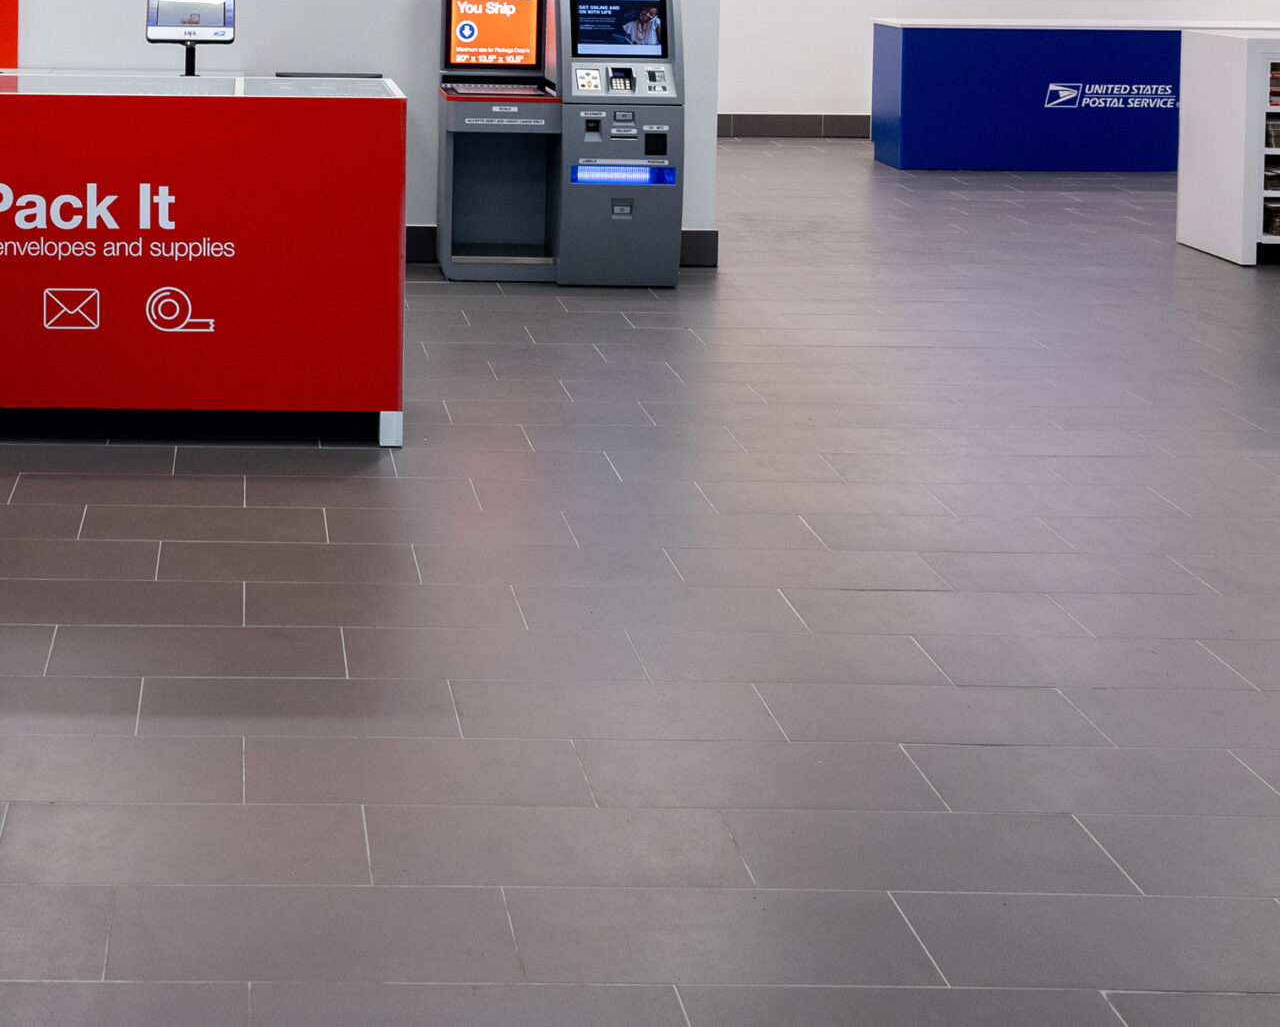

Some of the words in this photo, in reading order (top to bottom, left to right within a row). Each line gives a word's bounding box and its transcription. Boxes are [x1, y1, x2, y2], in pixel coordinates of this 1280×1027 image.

[457, 1, 482, 14] You
[485, 1, 516, 17] Ship
[1085, 84, 1130, 94] UNITED
[1131, 85, 1172, 95] STATES
[1081, 98, 1126, 108] POSTAL
[1127, 98, 1175, 108] SERVICE
[139, 183, 176, 230] It
[103, 237, 143, 257] and
[150, 238, 235, 261] supplies
